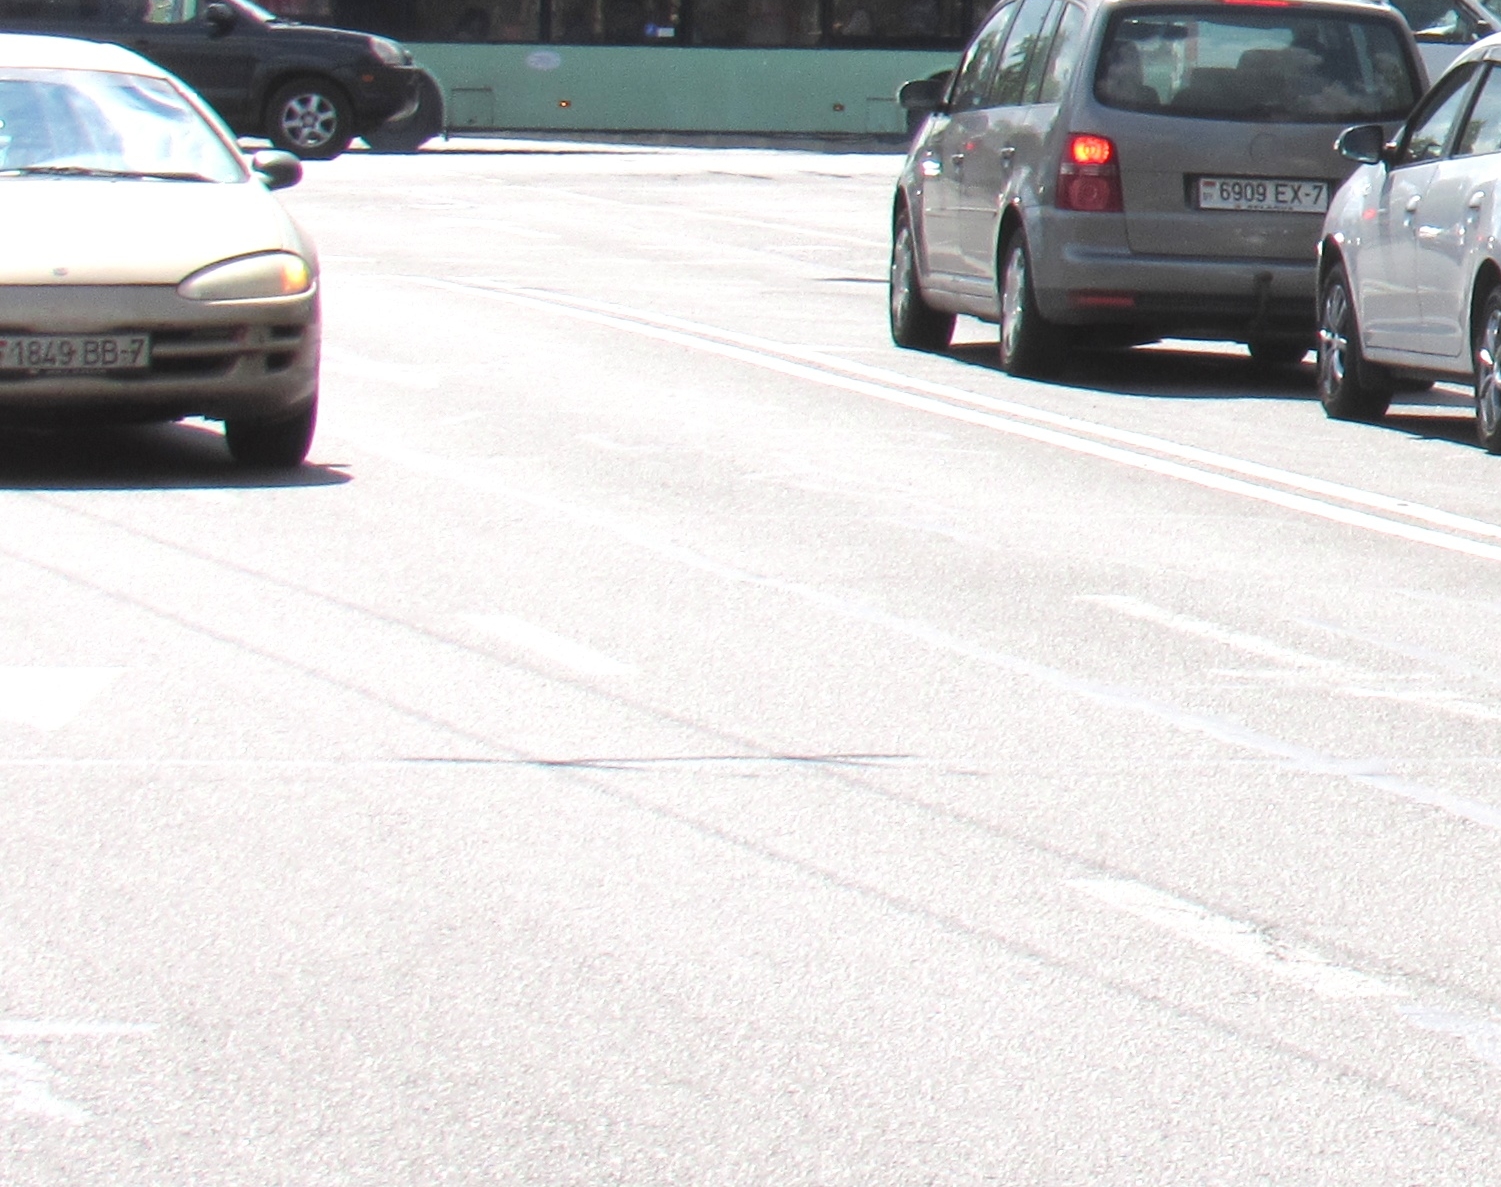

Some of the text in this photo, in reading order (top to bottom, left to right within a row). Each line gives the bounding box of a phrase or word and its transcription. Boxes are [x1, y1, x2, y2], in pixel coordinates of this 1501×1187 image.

[1219, 181, 1324, 206] 6909 EX-7
[15, 338, 146, 366] 1849 BB-7
